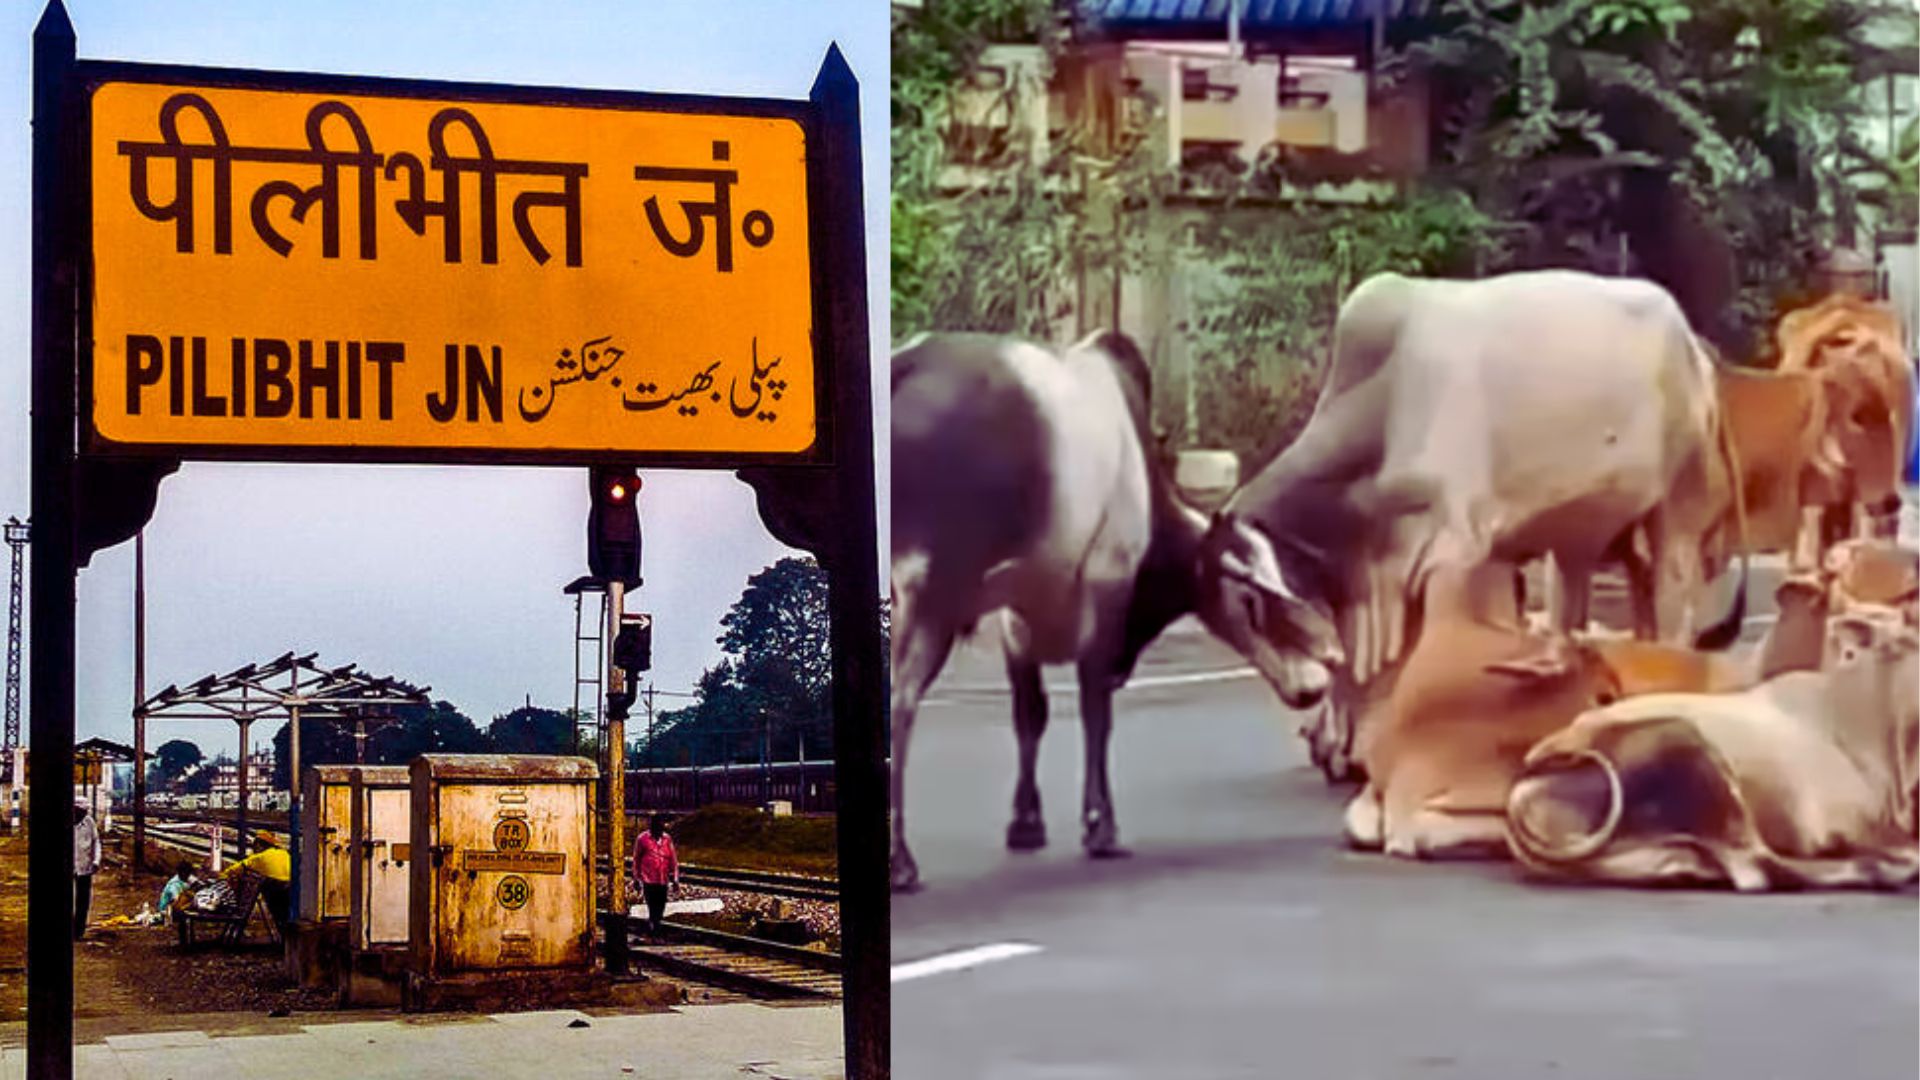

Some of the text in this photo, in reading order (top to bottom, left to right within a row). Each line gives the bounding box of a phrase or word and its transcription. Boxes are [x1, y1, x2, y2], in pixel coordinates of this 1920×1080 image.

[117, 92, 589, 268] पीलीभीत
[125, 334, 503, 423] PILIBHIT JN
[518, 335, 788, 423] پیلی بھیت جنکشن
[502, 882, 526, 903] 38
